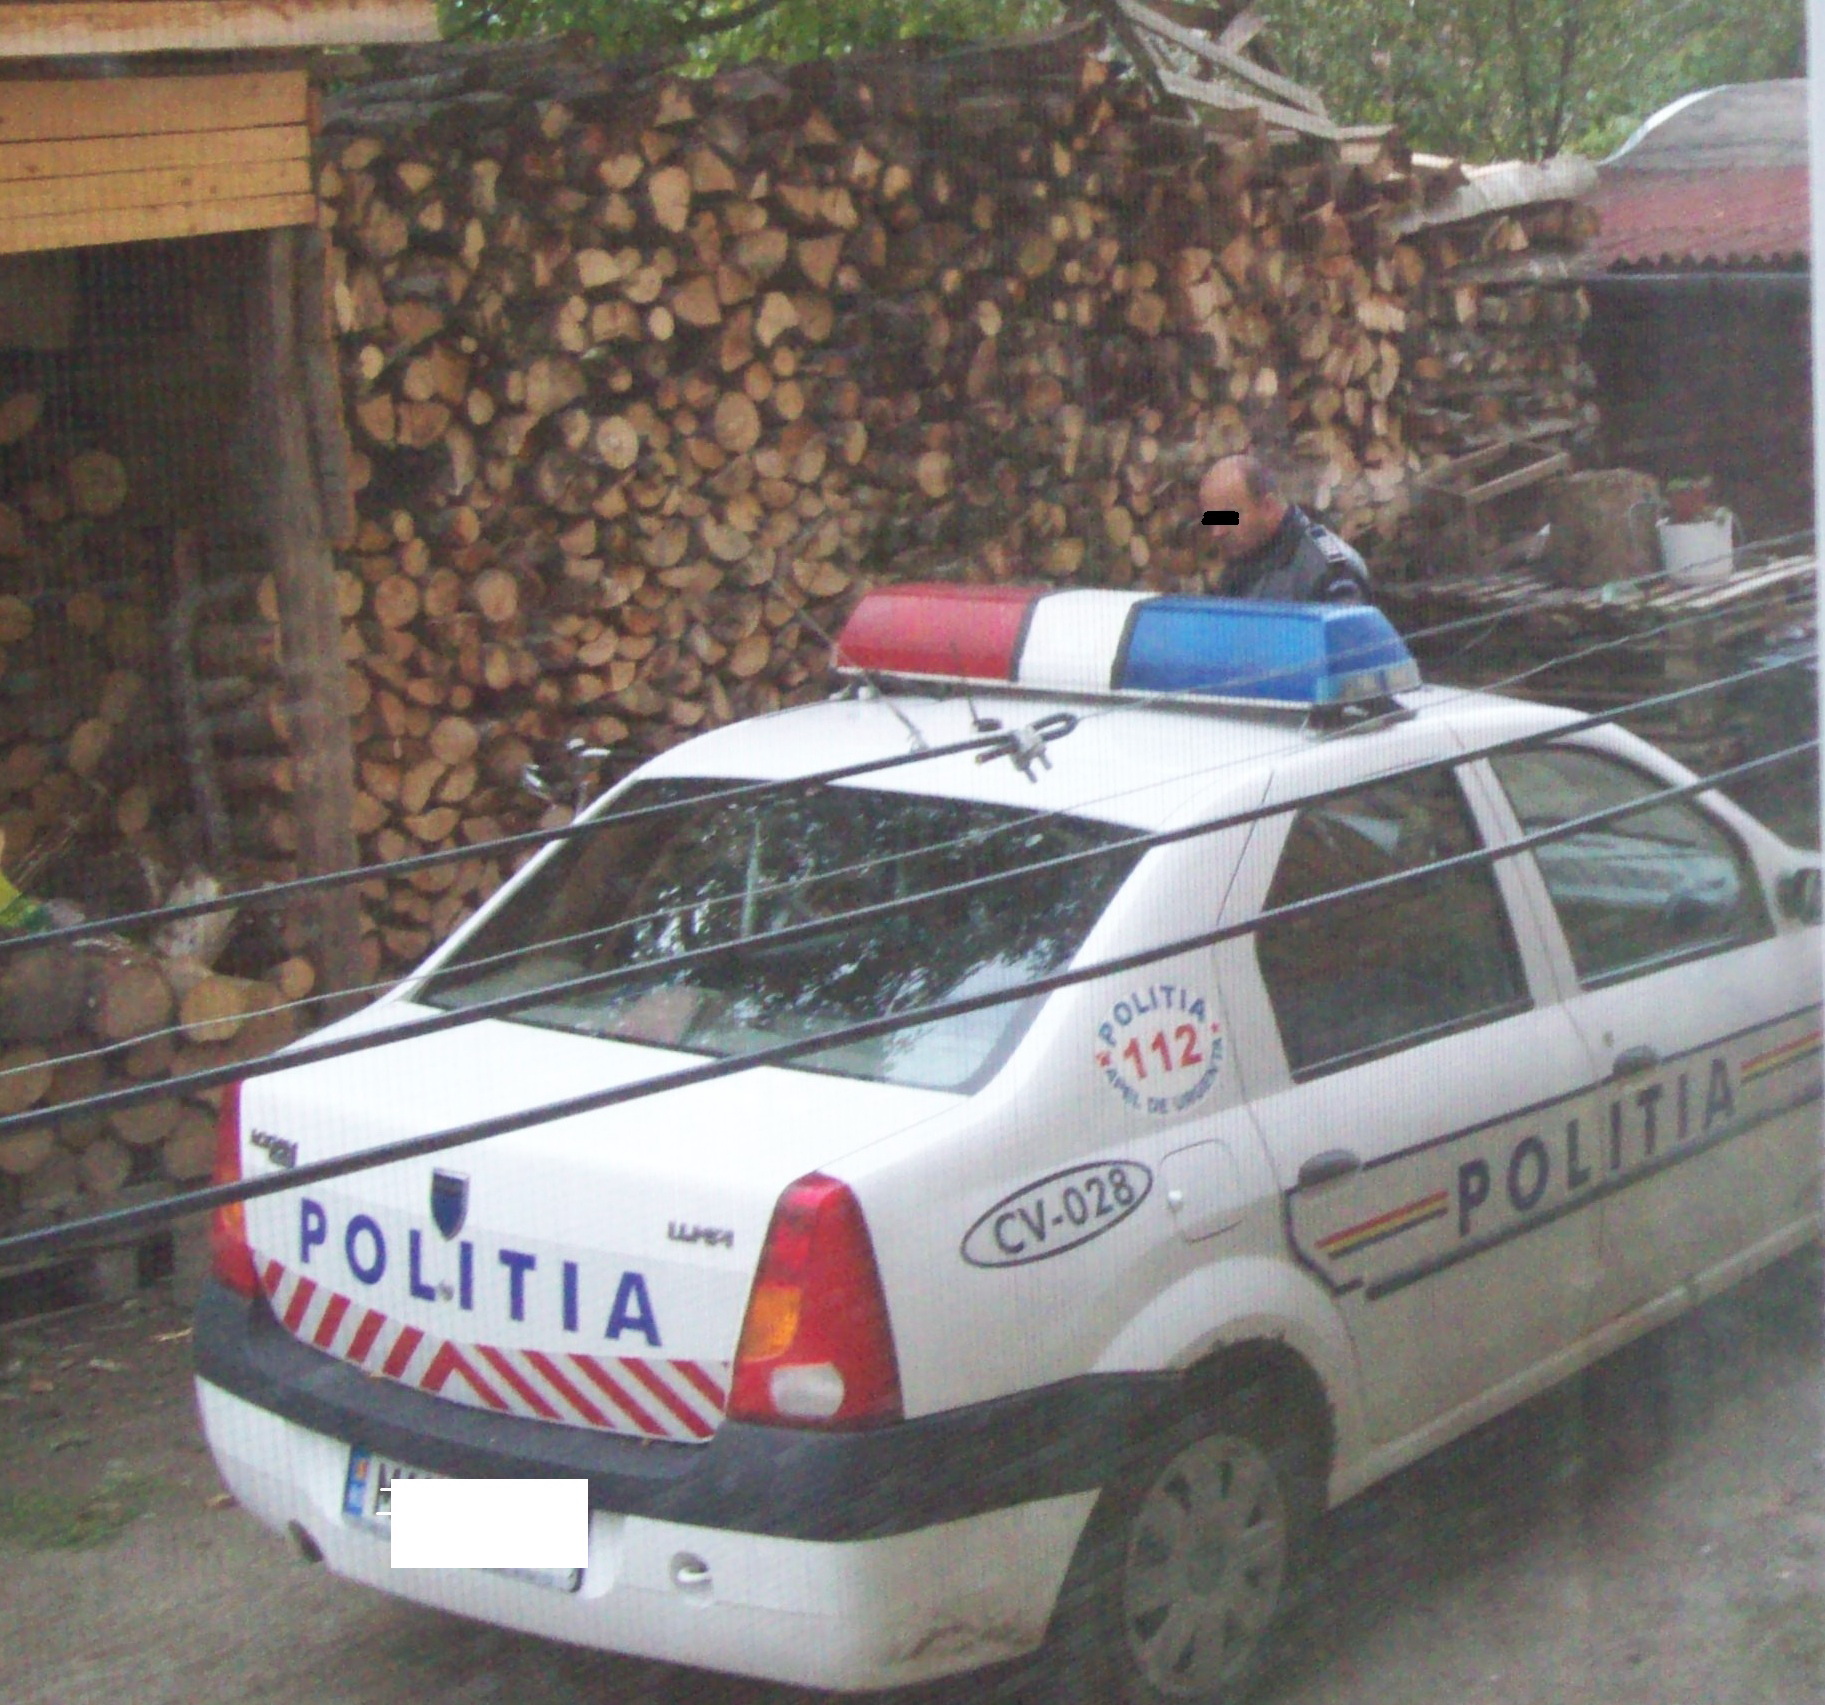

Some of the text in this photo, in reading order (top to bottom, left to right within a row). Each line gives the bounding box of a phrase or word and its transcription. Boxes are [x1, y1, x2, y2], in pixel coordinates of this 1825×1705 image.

[1098, 985, 1206, 1047] POLITIA
[1123, 1023, 1203, 1079] 112
[1457, 1057, 1734, 1236] POLITIA
[994, 1168, 1134, 1254] CV-028
[300, 1197, 662, 1347] POLITIA
